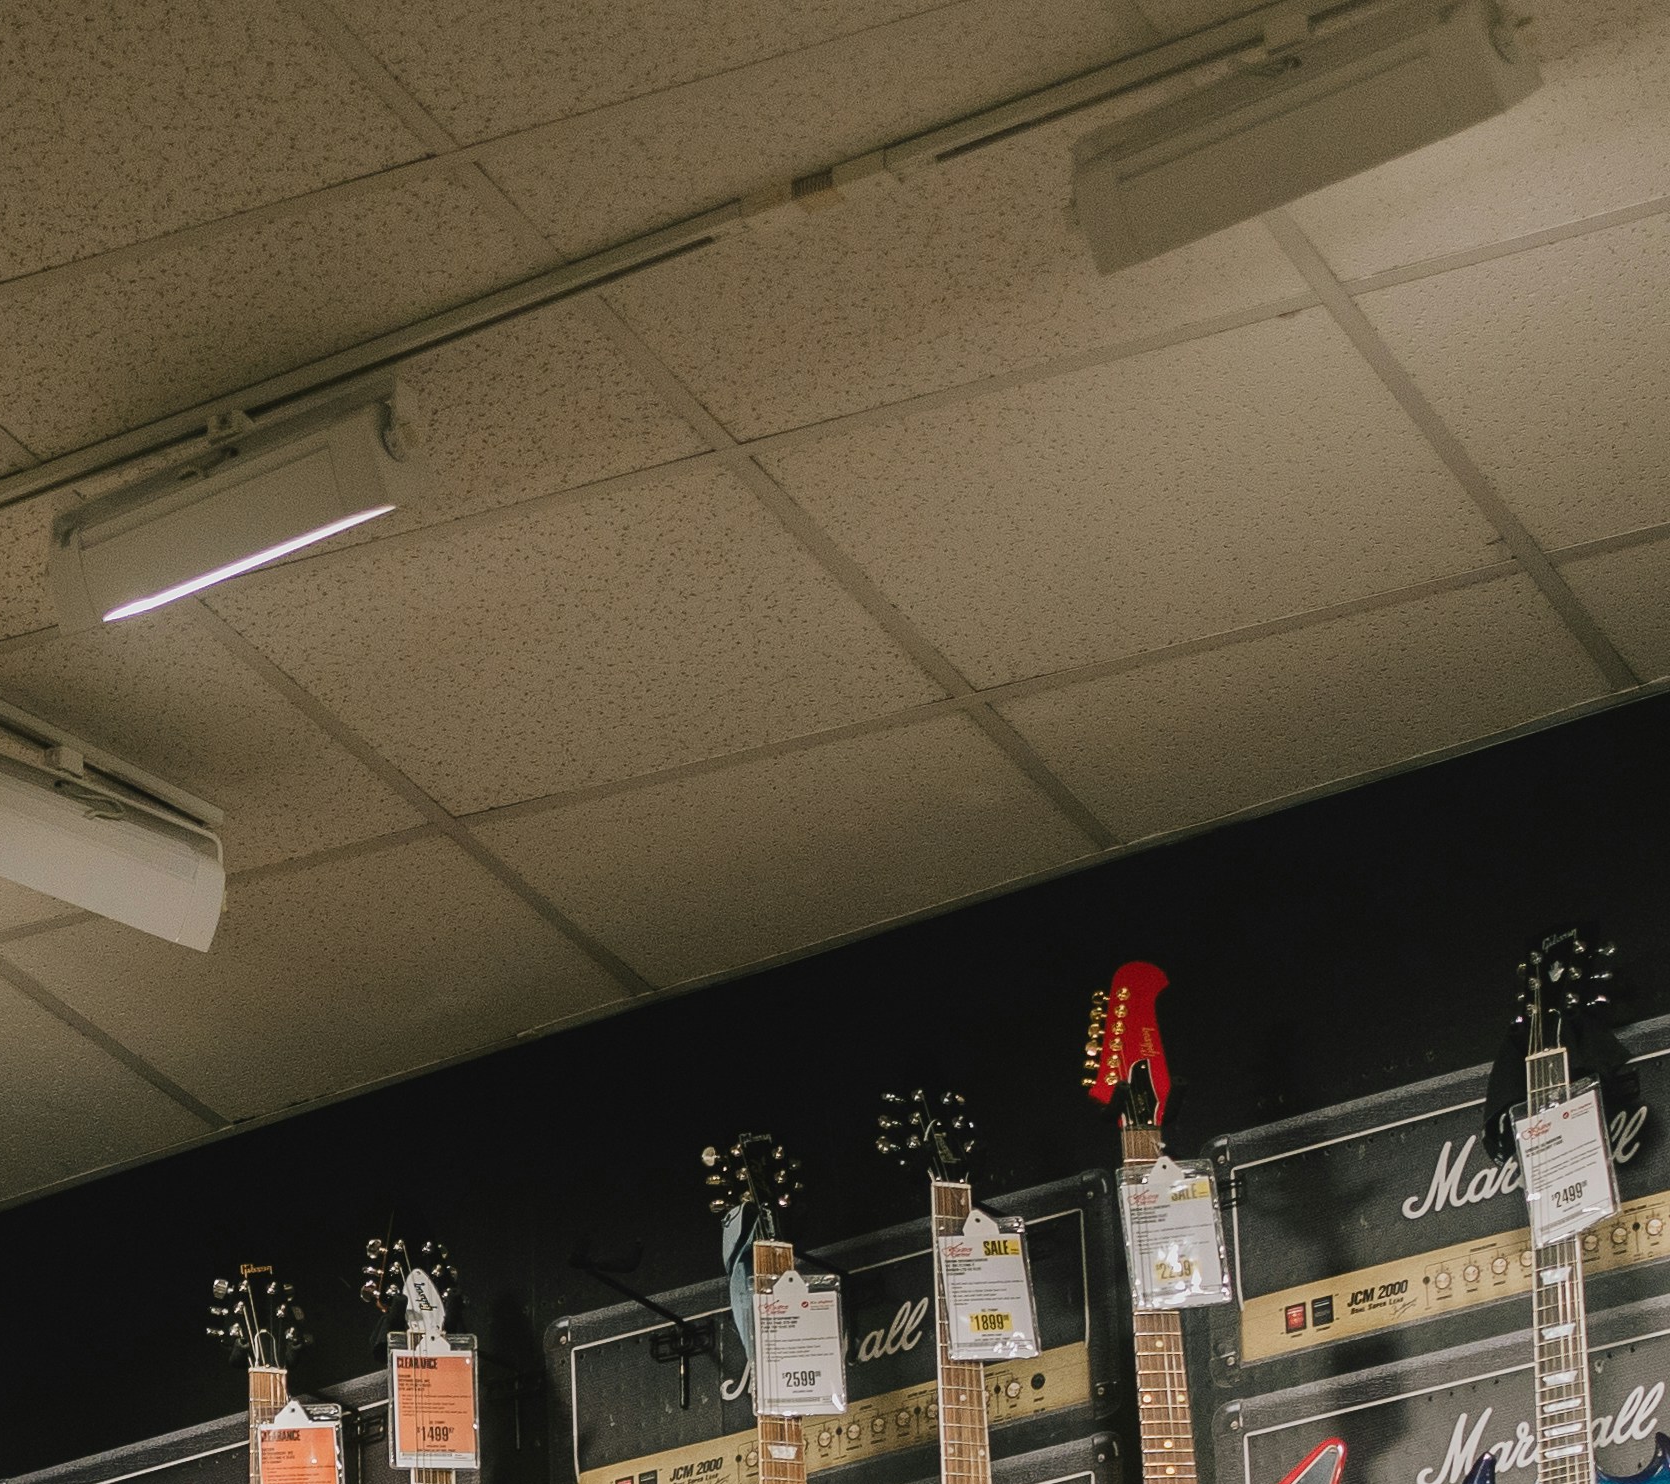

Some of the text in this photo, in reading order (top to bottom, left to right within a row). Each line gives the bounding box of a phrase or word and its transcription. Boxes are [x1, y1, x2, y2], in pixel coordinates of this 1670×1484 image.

[983, 1240, 1009, 1256] SALE
[1347, 1280, 1409, 1308] JCM 2000
[669, 1457, 724, 1482] JCM 2000
